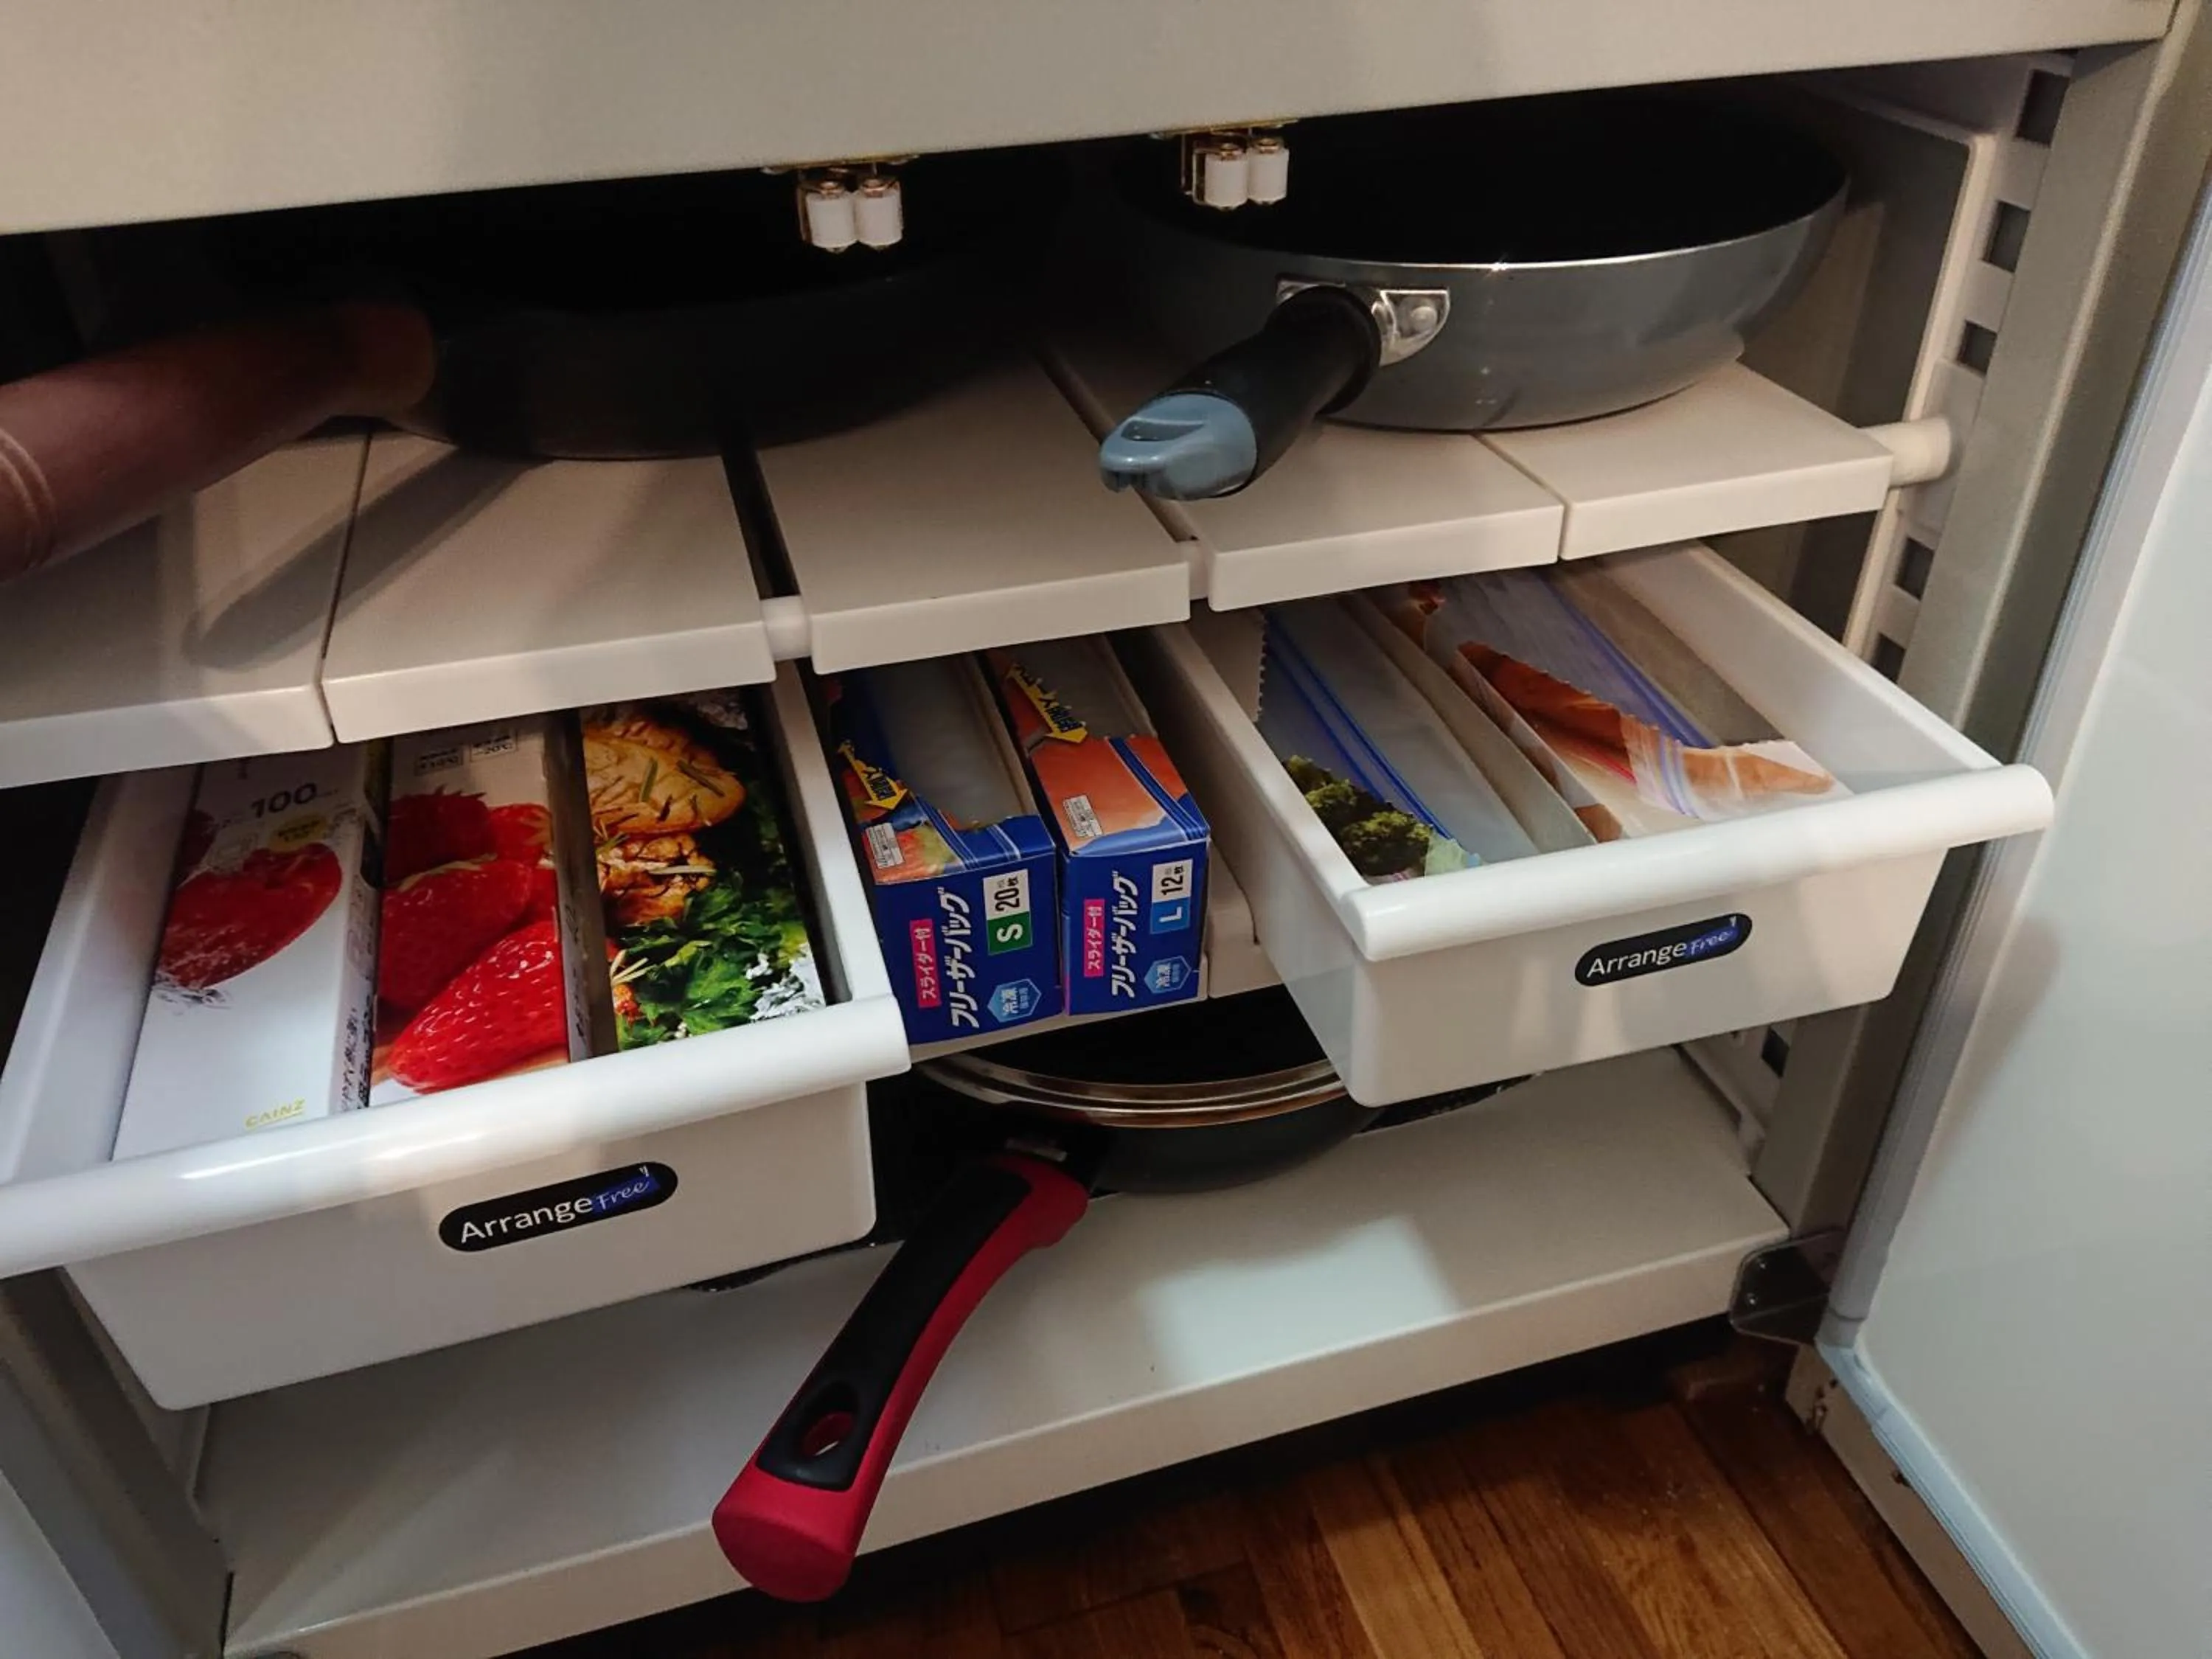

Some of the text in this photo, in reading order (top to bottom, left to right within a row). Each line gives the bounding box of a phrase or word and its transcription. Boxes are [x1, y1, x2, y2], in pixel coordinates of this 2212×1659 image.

[251, 782, 317, 818] 100
[996, 924, 1023, 943] S
[1088, 906, 1102, 970] スライダー付
[1111, 871, 1138, 998] フリーザーバッグ
[1159, 906, 1182, 922] L
[914, 928, 936, 999] スライダー付
[938, 887, 980, 1028] フリーザーバッグ
[245, 1097, 305, 1128] CAINZ
